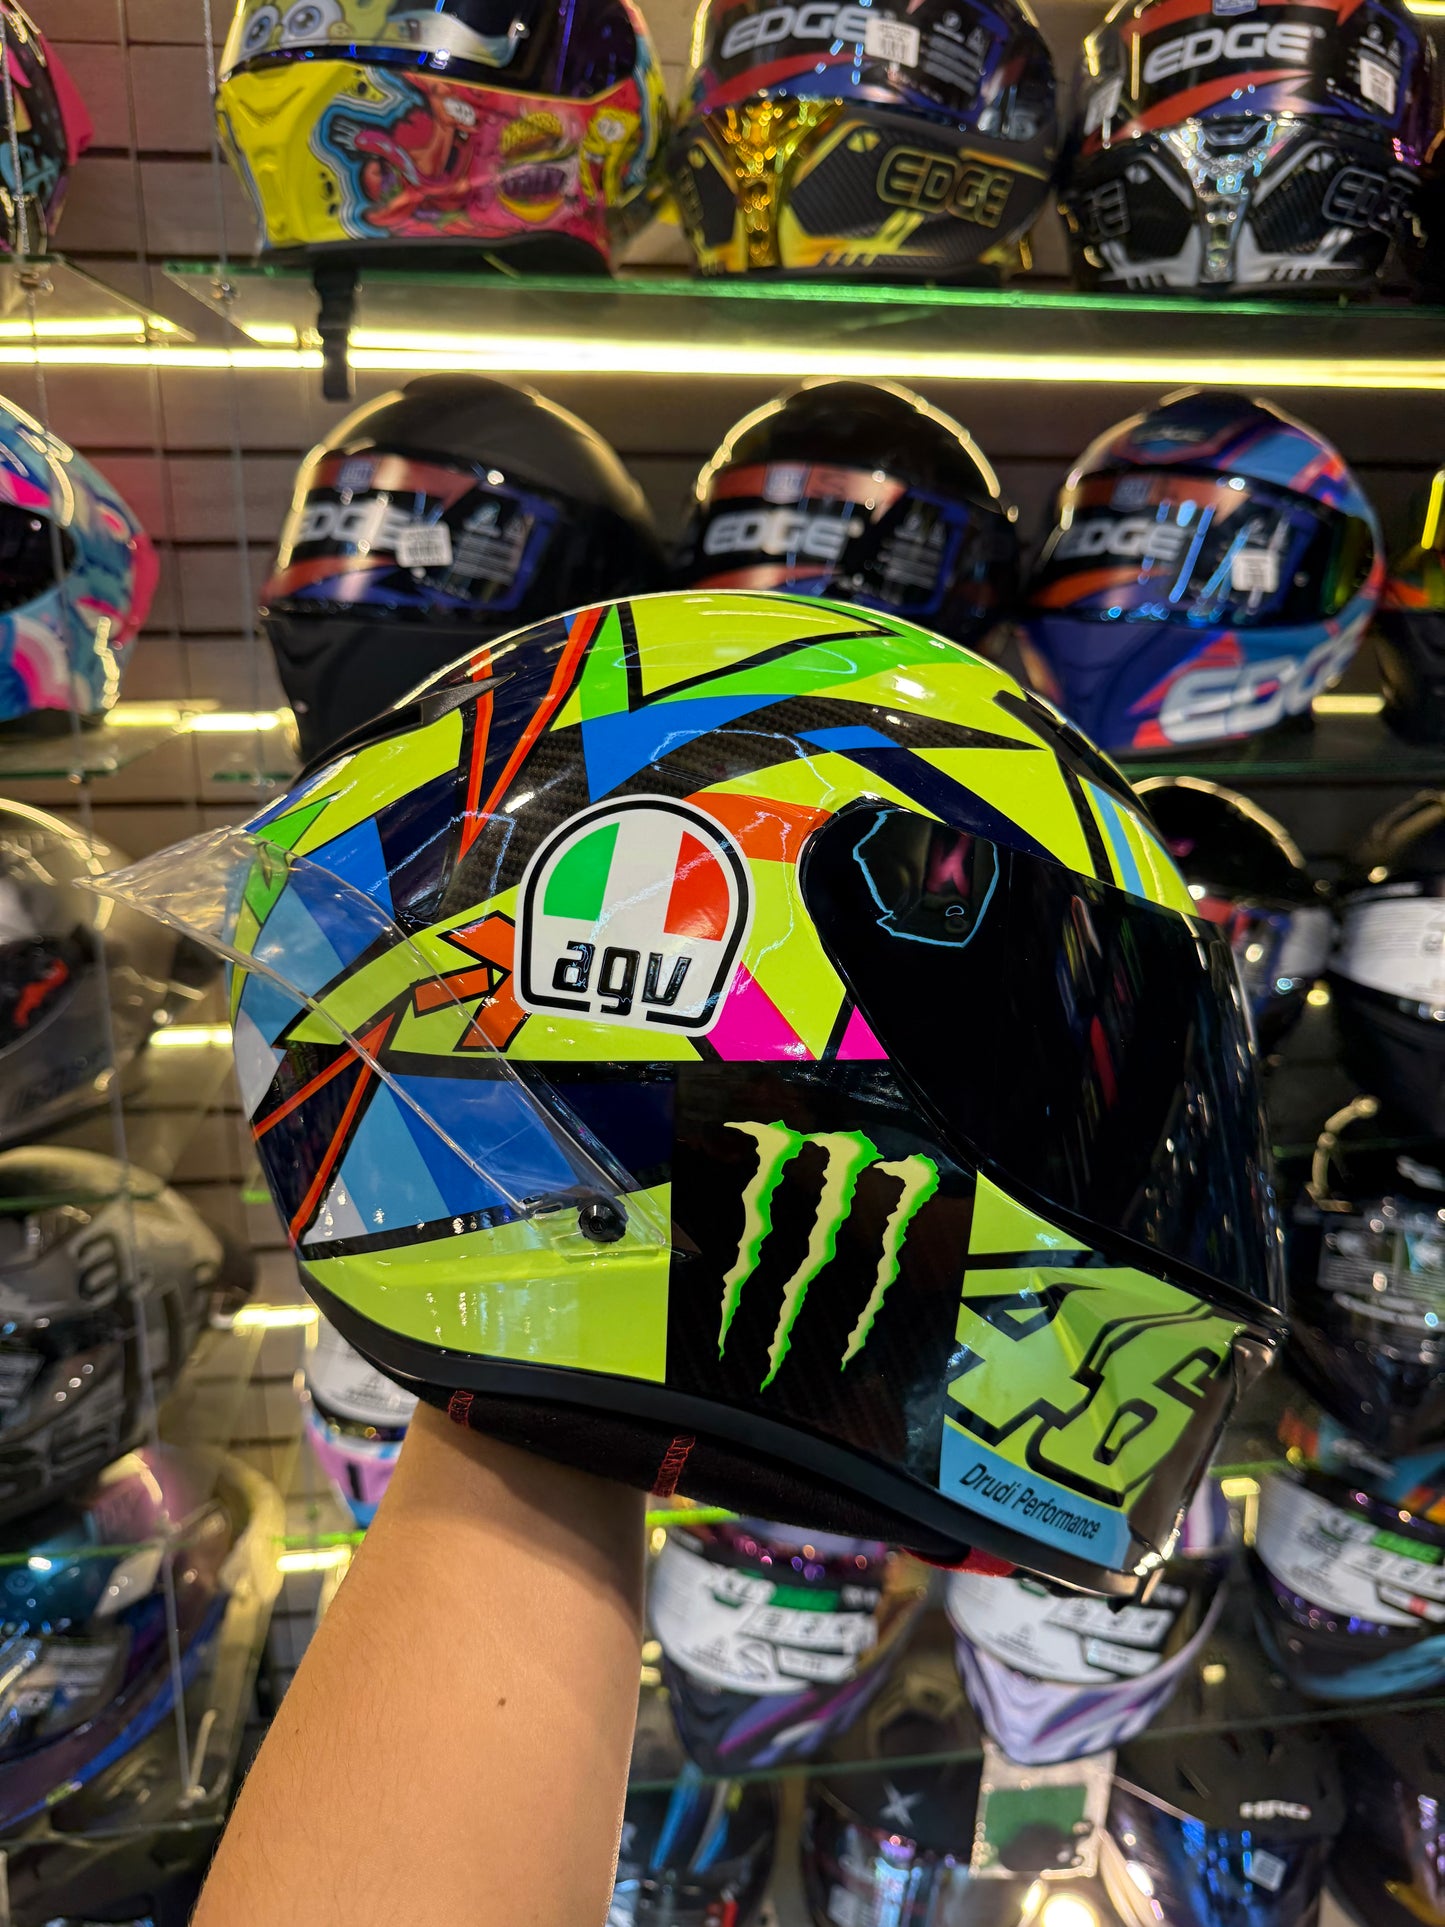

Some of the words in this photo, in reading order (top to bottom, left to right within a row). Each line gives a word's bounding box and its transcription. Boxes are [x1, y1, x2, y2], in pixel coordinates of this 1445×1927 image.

[721, 4, 880, 60] EDGE
[1143, 22, 1312, 85] EDGE
[876, 145, 1015, 229] EDGE
[296, 501, 411, 552] DGE
[703, 508, 850, 563] EDGE
[1053, 518, 1188, 562] EDGE
[552, 940, 692, 1017] agv
[946, 1283, 1226, 1507] 46
[959, 1462, 1018, 1506] Drudi
[1013, 1487, 1102, 1539] Performance
